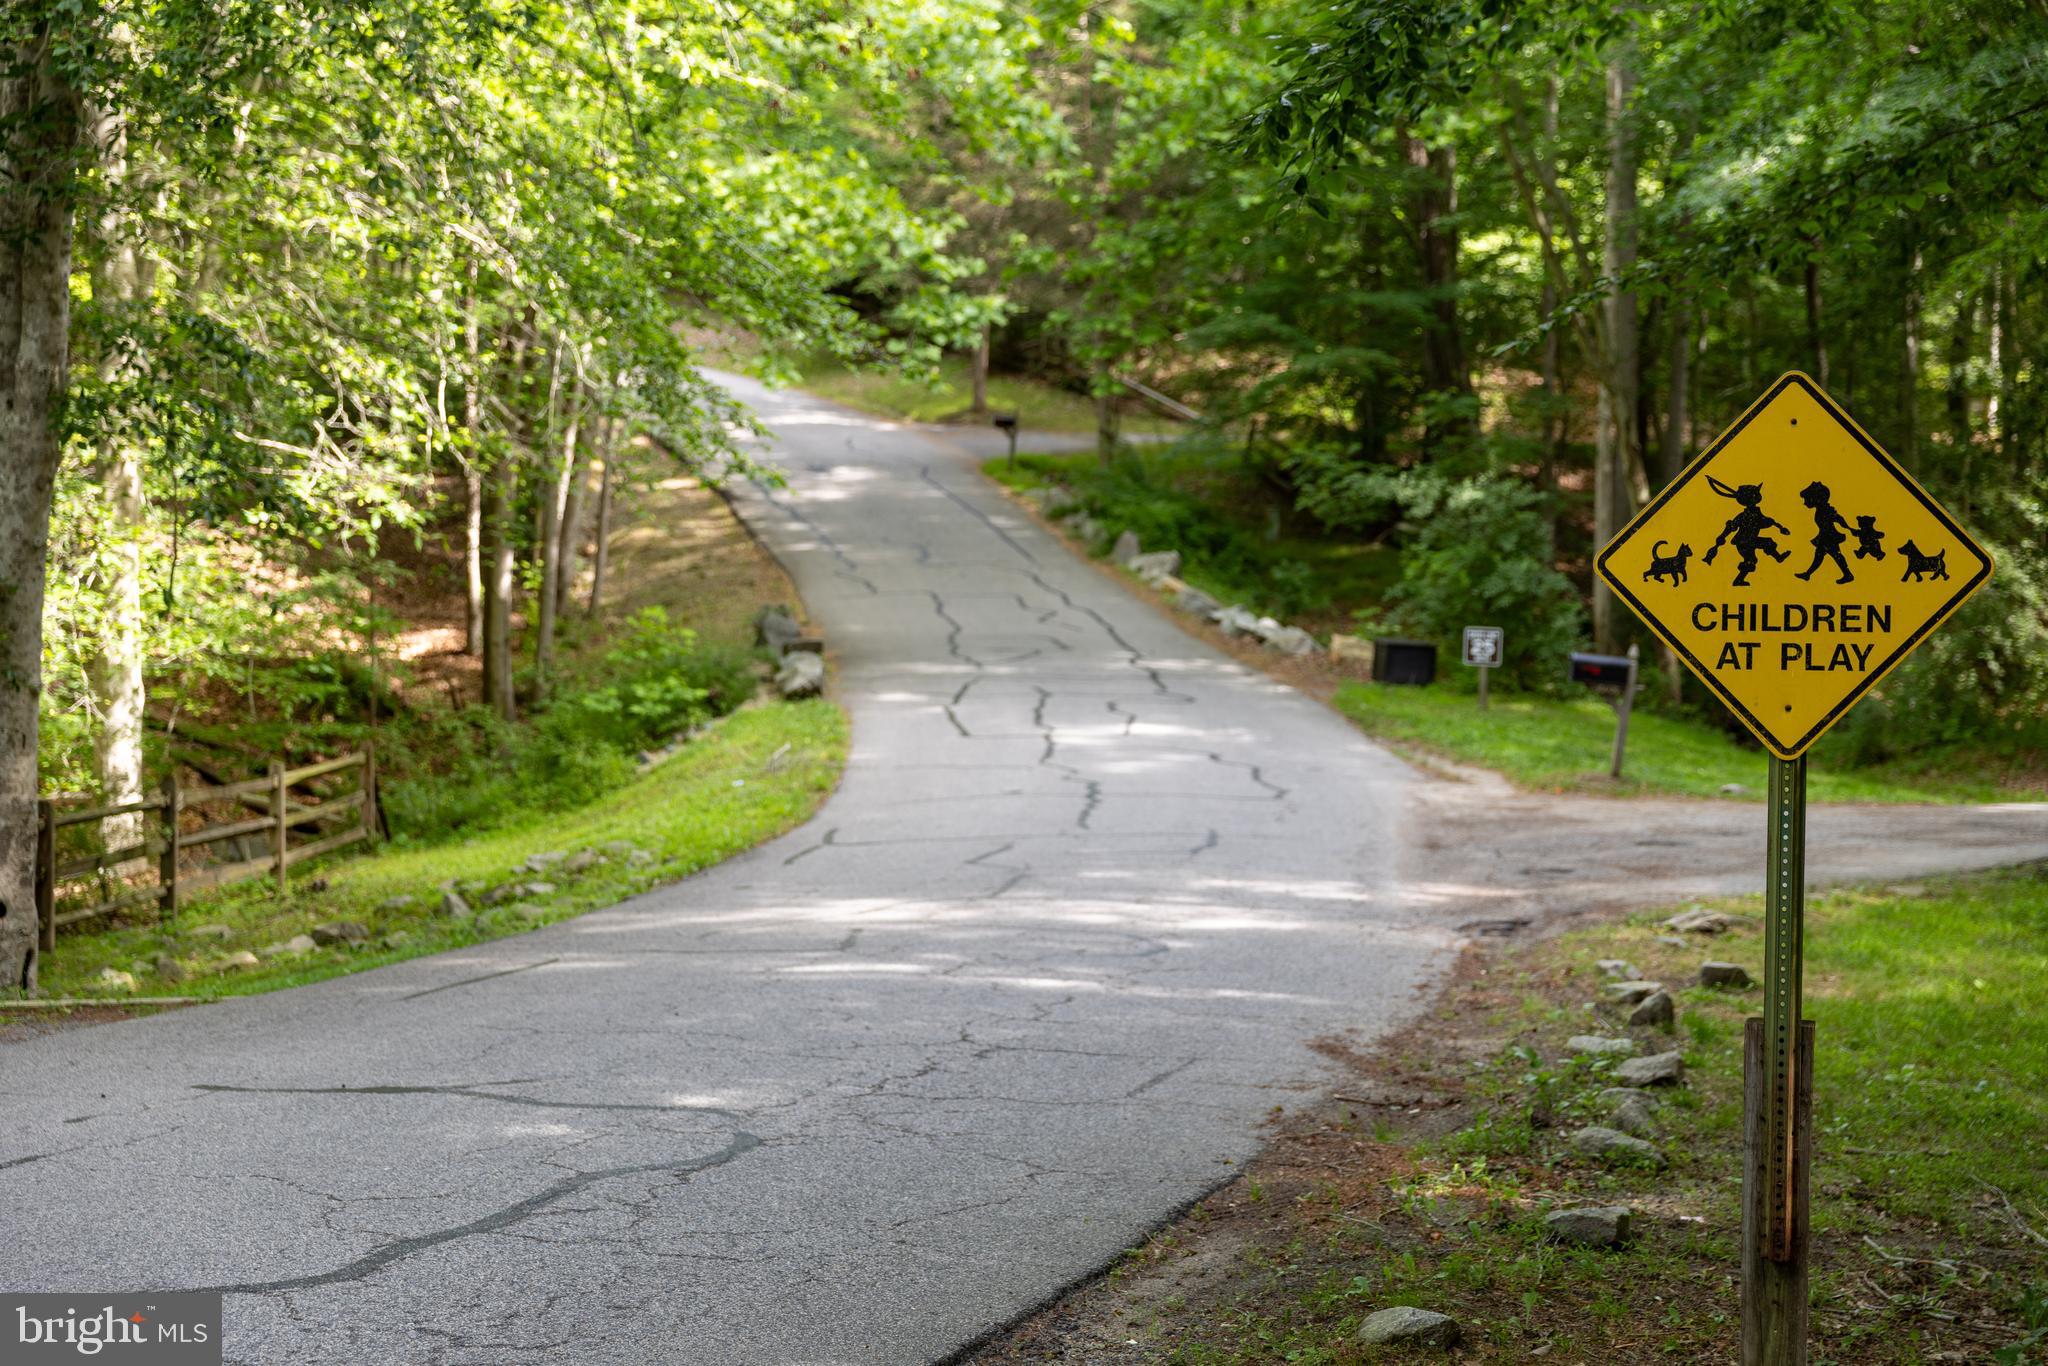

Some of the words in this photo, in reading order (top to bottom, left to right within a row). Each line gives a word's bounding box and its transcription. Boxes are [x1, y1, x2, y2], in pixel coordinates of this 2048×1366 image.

[1691, 602, 1892, 633] CHILDREN
[1715, 642, 1762, 671] AT
[1780, 642, 1876, 672] PLAY
